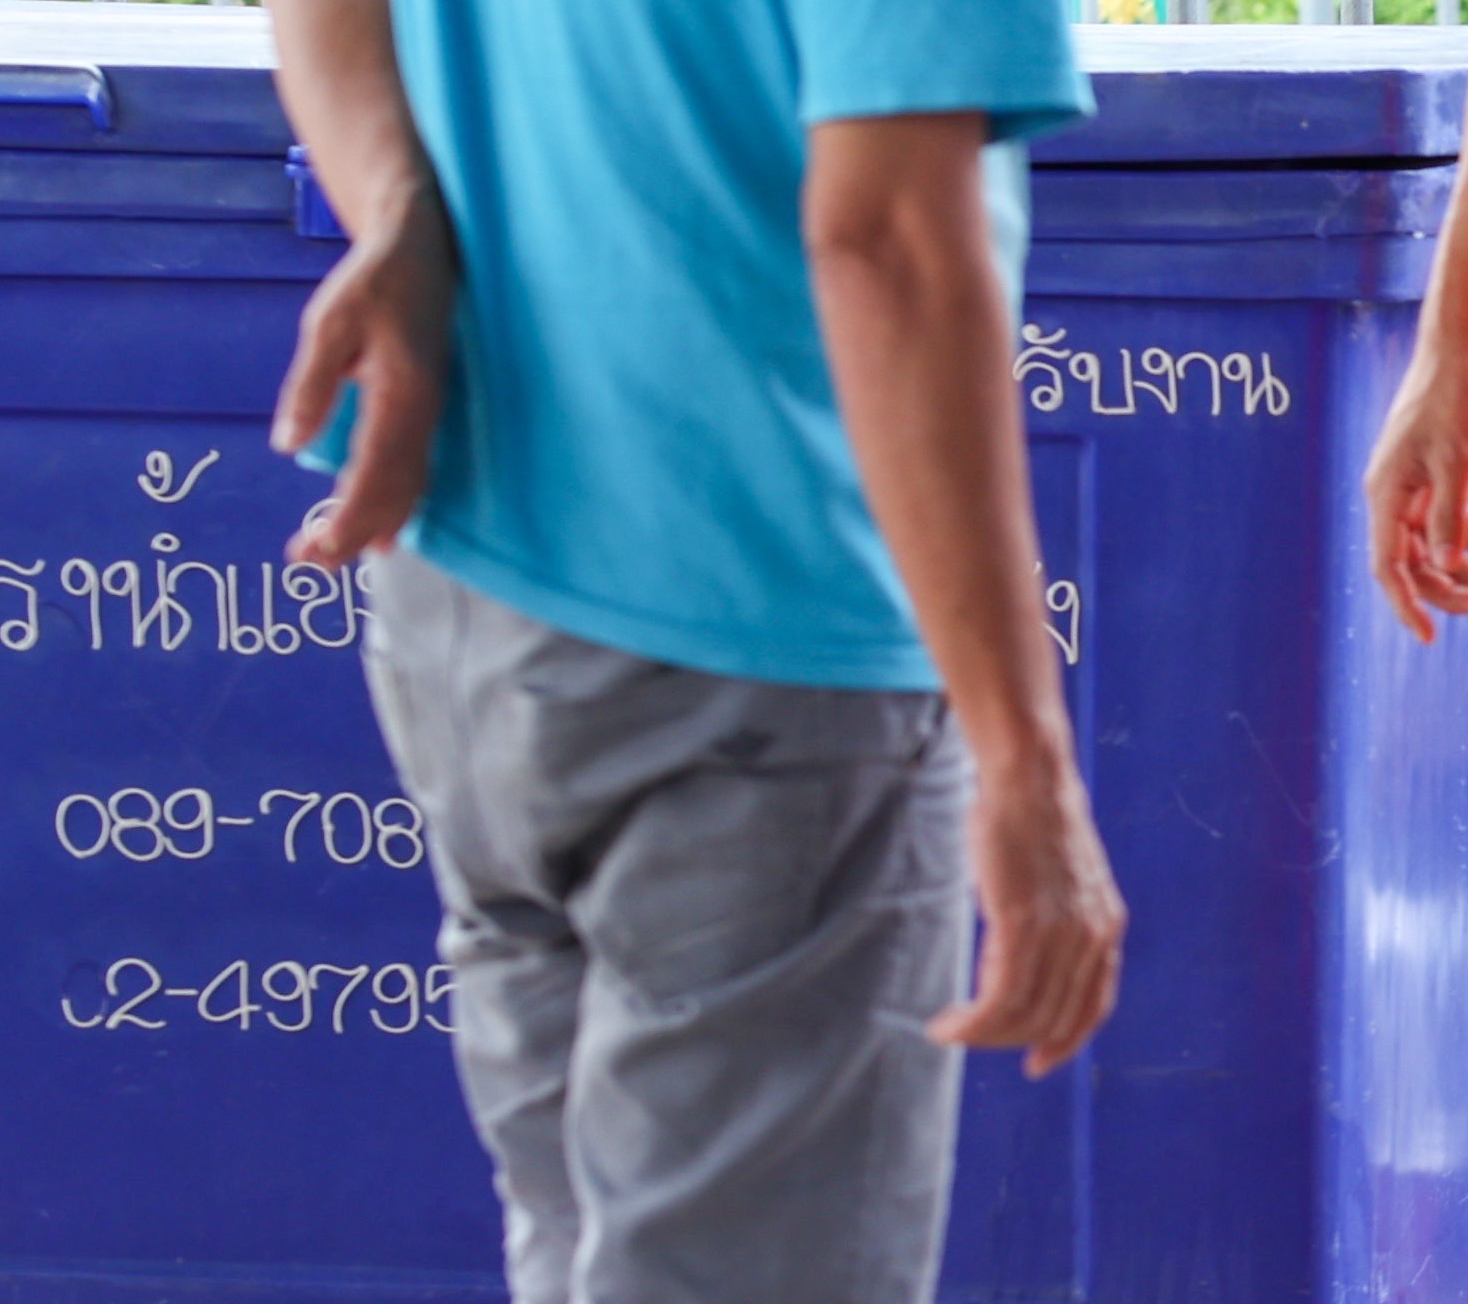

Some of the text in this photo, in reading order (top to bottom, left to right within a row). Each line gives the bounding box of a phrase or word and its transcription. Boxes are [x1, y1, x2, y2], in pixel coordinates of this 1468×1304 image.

[1013, 324, 1291, 416] รับงาน
[55, 787, 425, 869] 089-708
